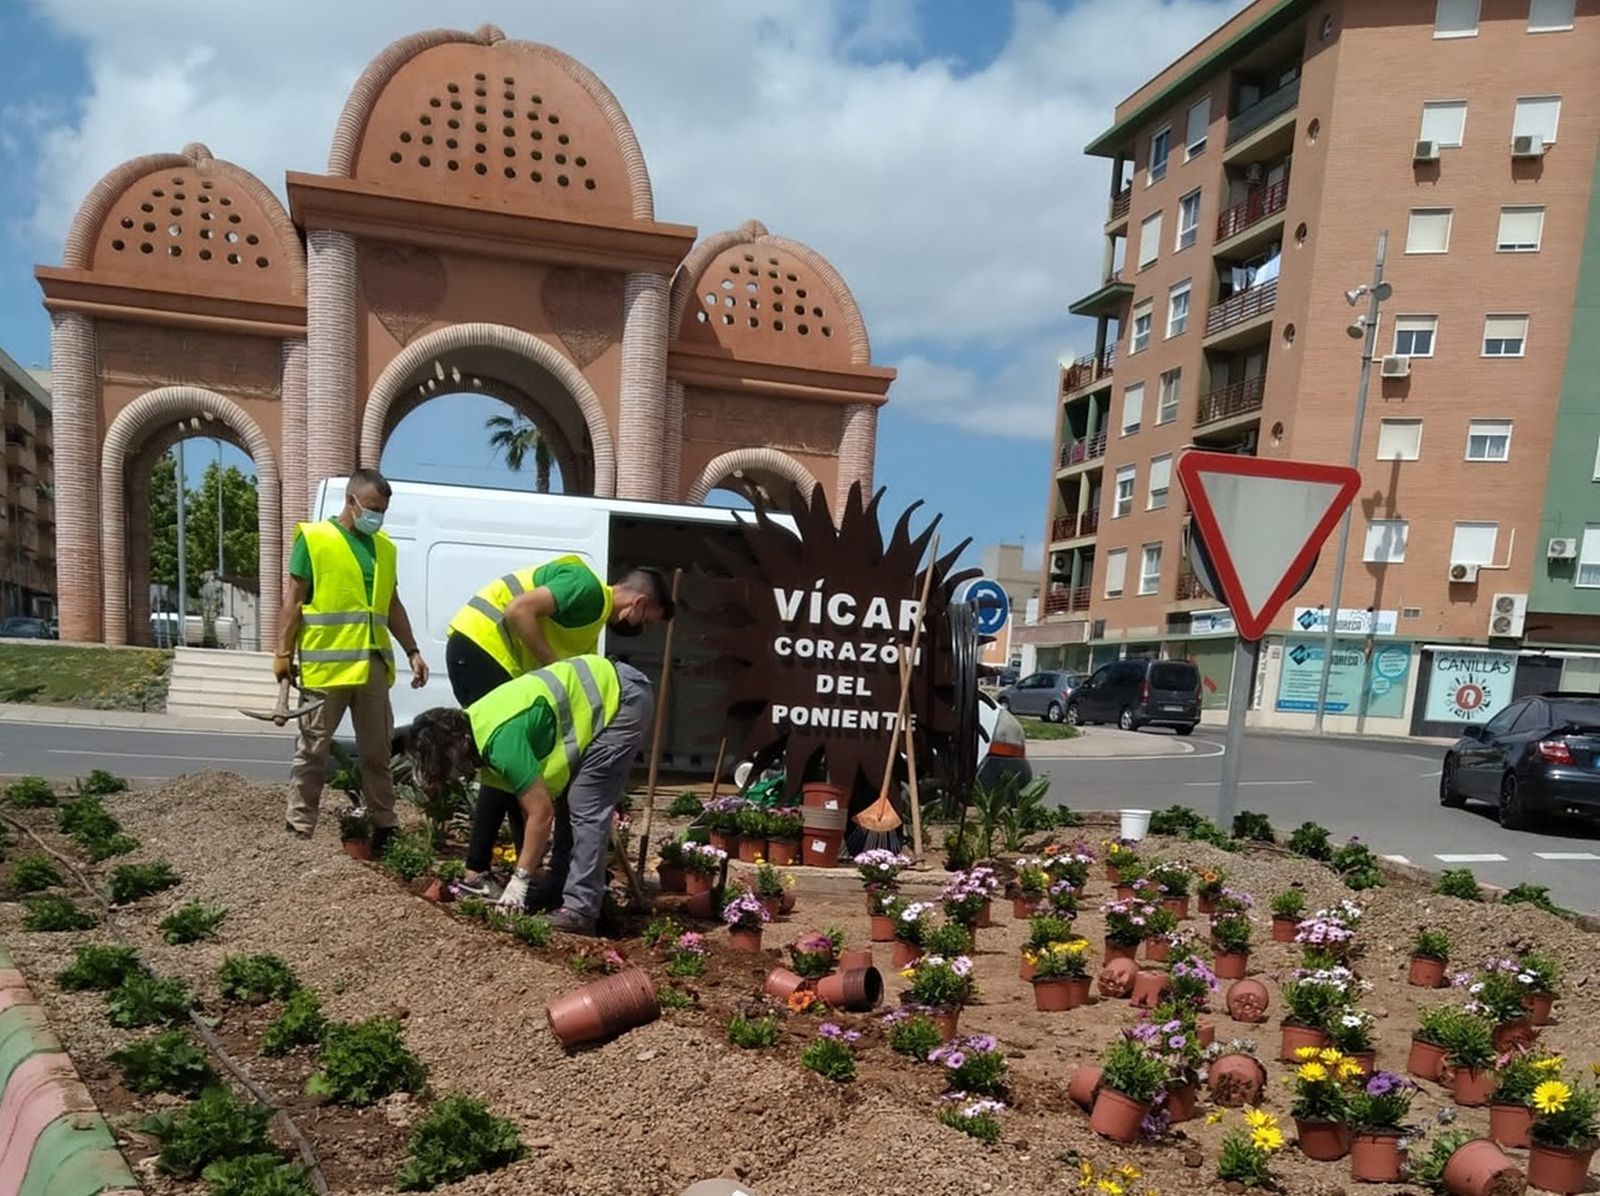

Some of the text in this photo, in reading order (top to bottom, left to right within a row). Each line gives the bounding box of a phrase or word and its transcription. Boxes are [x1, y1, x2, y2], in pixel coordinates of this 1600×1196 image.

[773, 578, 926, 632] VÍCAR
[1437, 657, 1511, 675] CANILLAS
[816, 674, 872, 696] DEL
